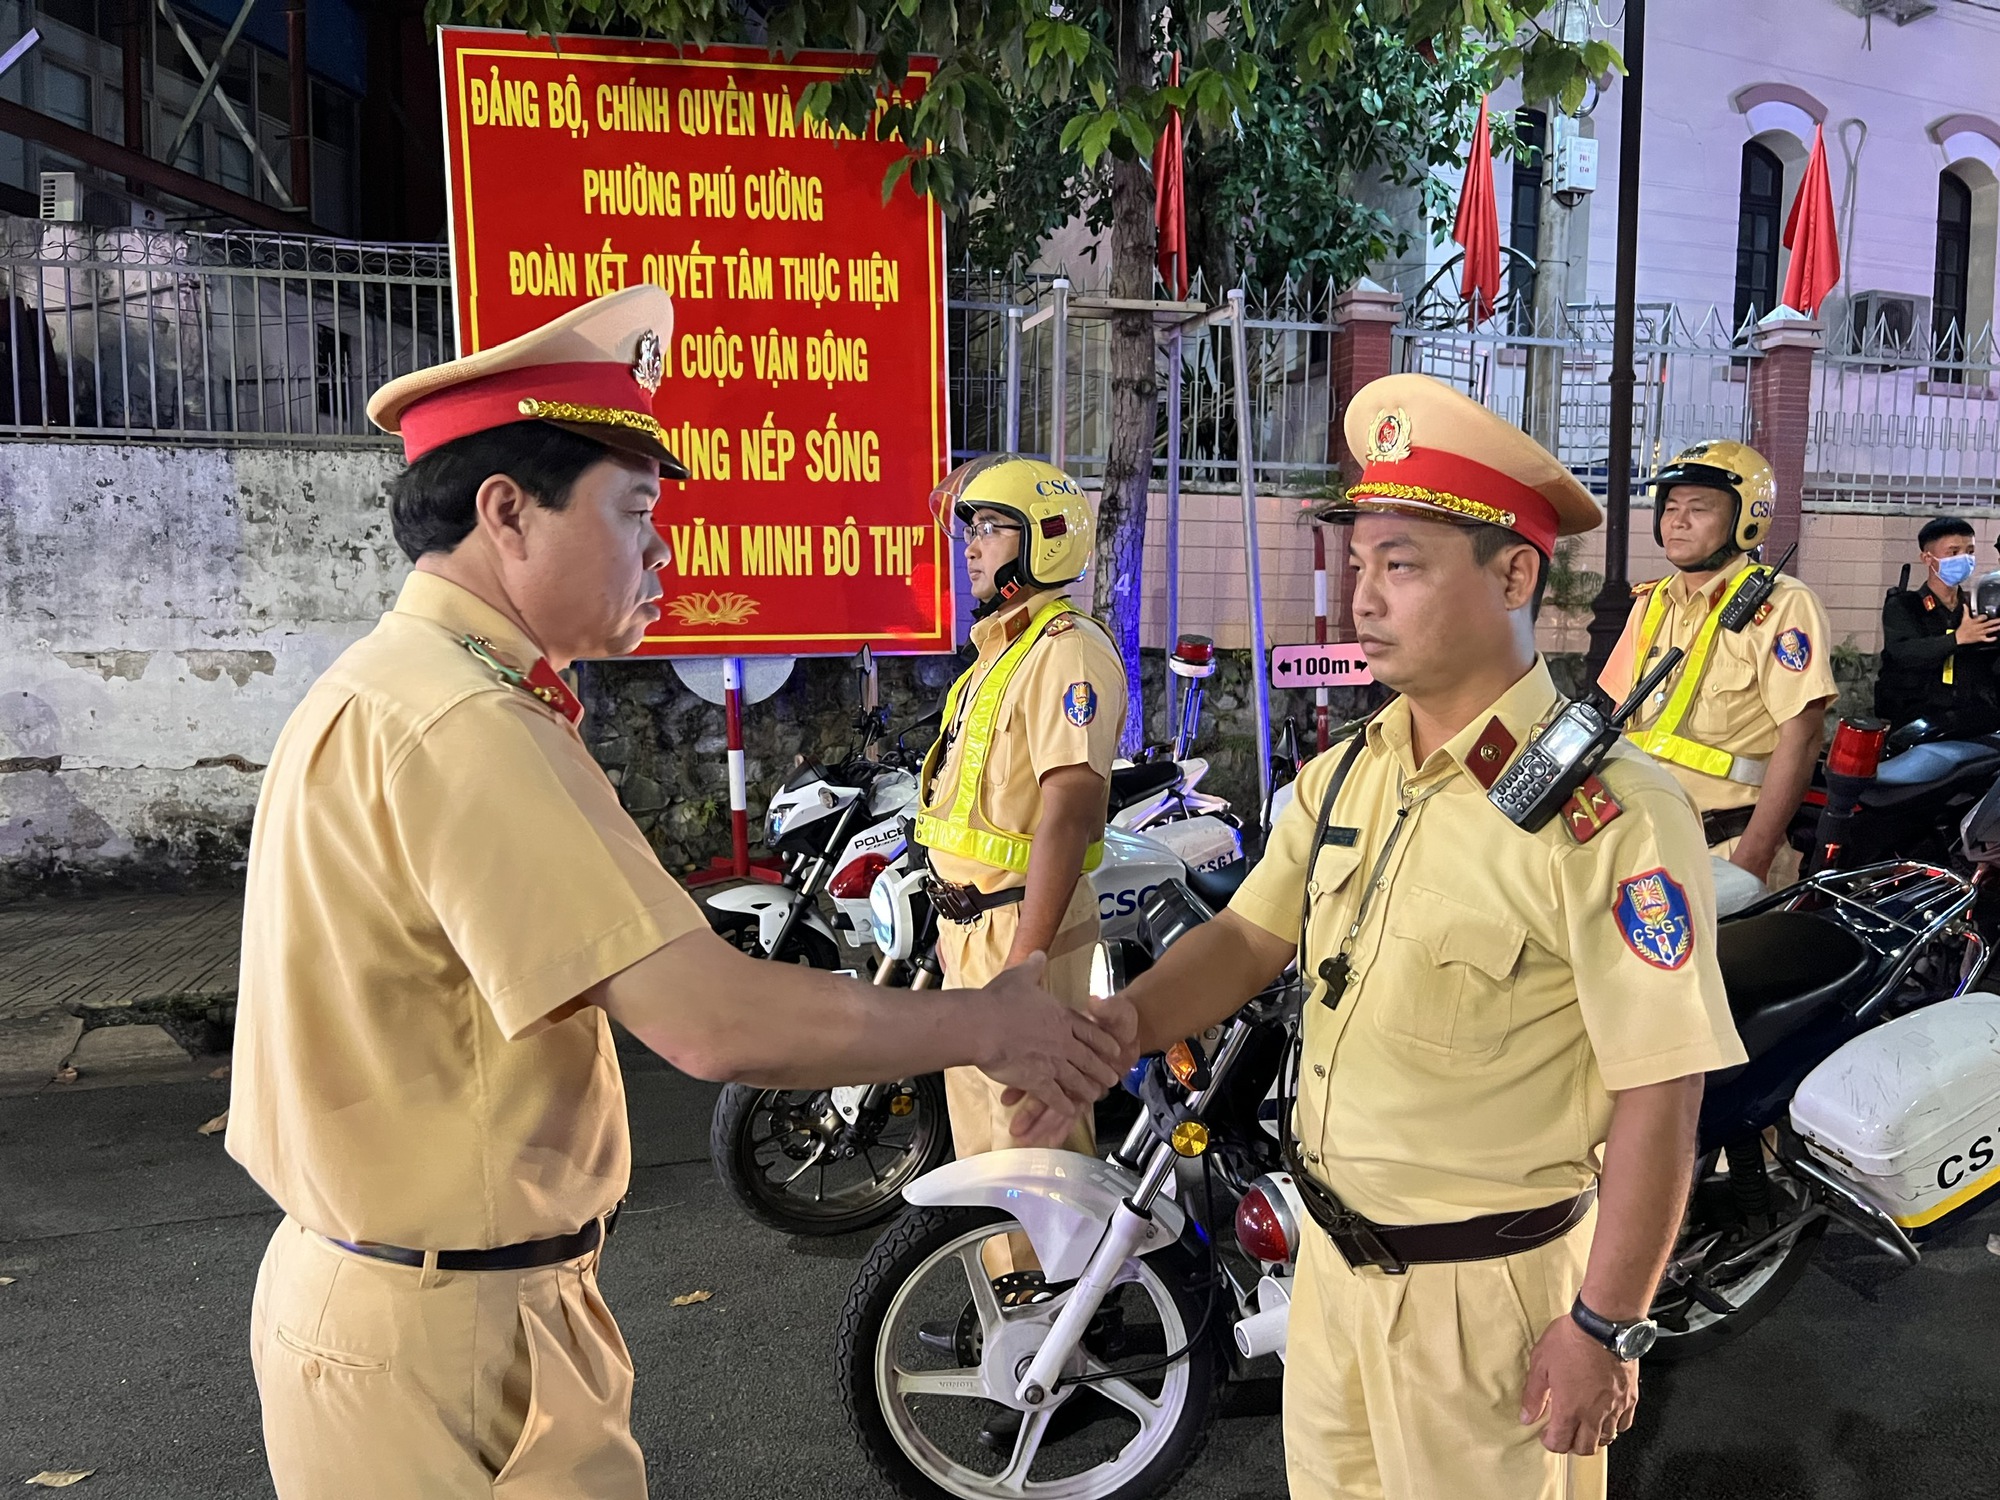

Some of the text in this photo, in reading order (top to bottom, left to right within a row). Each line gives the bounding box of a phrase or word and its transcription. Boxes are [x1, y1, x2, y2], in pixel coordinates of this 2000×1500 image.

[471, 65, 540, 129] ĐẢNG
[549, 74, 589, 139] BỘ,
[597, 77, 670, 133] CHÍNH
[679, 75, 756, 137] QUYỀN
[764, 84, 796, 138] VÀ
[583, 162, 823, 221] PHƯỜNG PHÚ CƯỜNG
[509, 238, 900, 310] ĐOÀN KẾT QUYẾT TÂM THỰC HIỆN
[681, 326, 744, 387] CUỘC
[751, 327, 799, 388] VẬN
[806, 329, 869, 390] ĐỘNG
[741, 411, 796, 482] NẾP
[805, 412, 880, 482] SỐNG
[671, 517, 730, 577] VĂN
[742, 525, 813, 576] MINH
[823, 516, 860, 576] ĐÔ
[1114, 573, 1130, 597] 4
[1293, 657, 1350, 676] 100m
[854, 827, 904, 849] POLICE
[1633, 915, 1685, 942] CSGT
